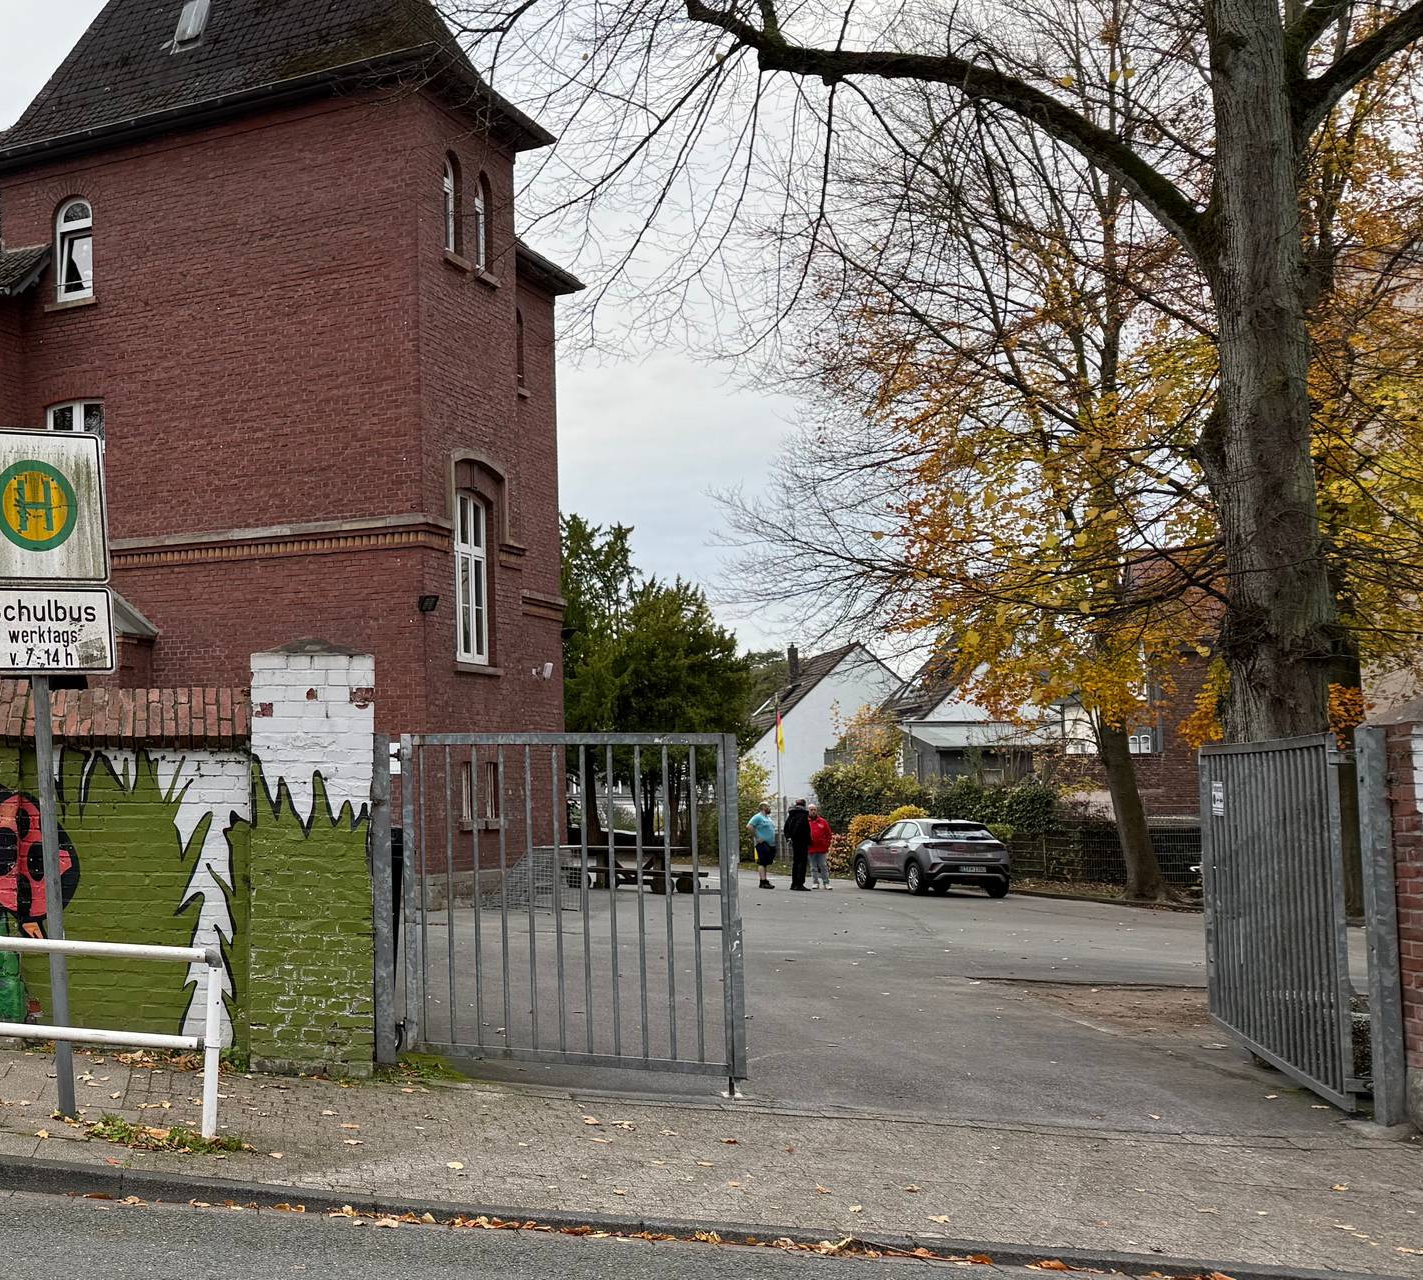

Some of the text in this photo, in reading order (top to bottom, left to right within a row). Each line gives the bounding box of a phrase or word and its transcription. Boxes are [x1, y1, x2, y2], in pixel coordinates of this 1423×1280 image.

[17, 480, 54, 531] H
[8, 625, 78, 648] werktags
[9, 651, 19, 666] v.
[65, 647, 73, 666] h
